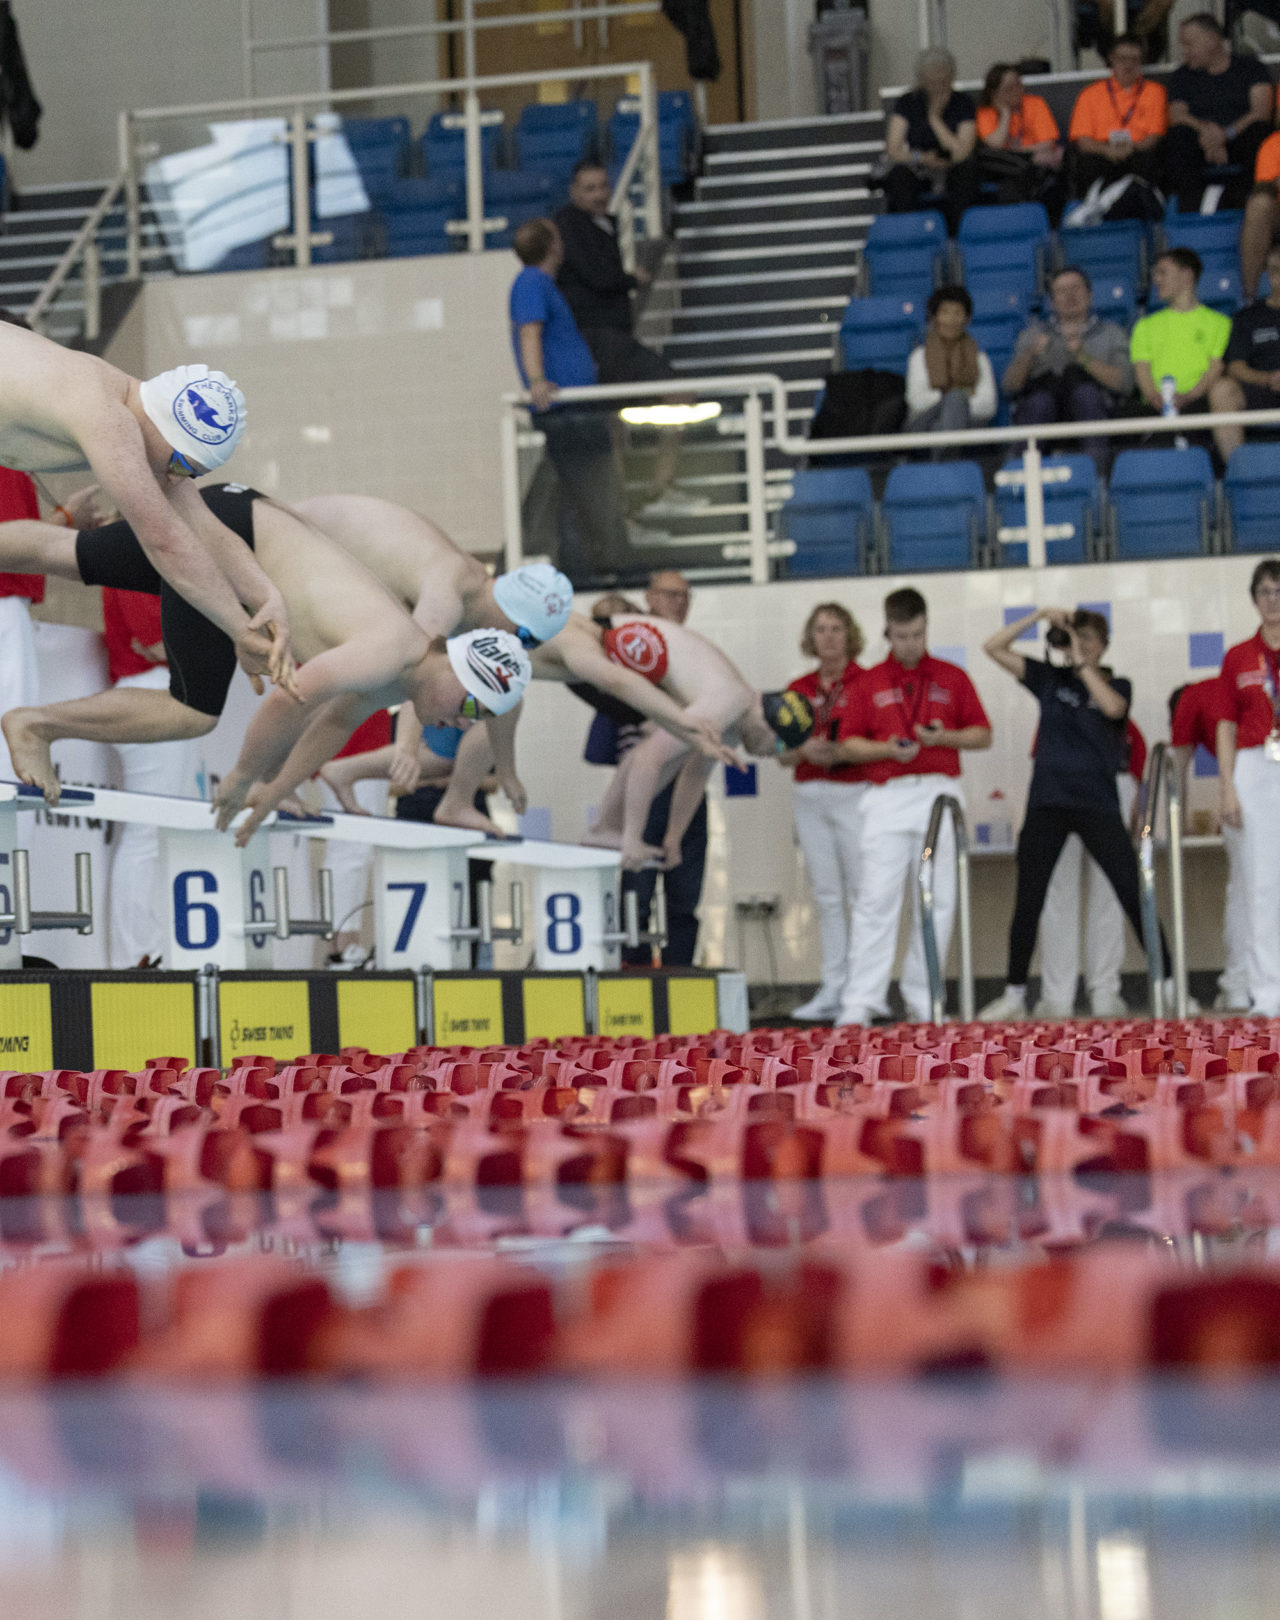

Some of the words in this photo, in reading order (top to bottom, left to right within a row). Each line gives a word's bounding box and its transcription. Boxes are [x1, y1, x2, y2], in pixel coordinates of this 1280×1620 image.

[173, 869, 219, 950] 6
[387, 882, 427, 952] 7
[546, 892, 581, 954] 8
